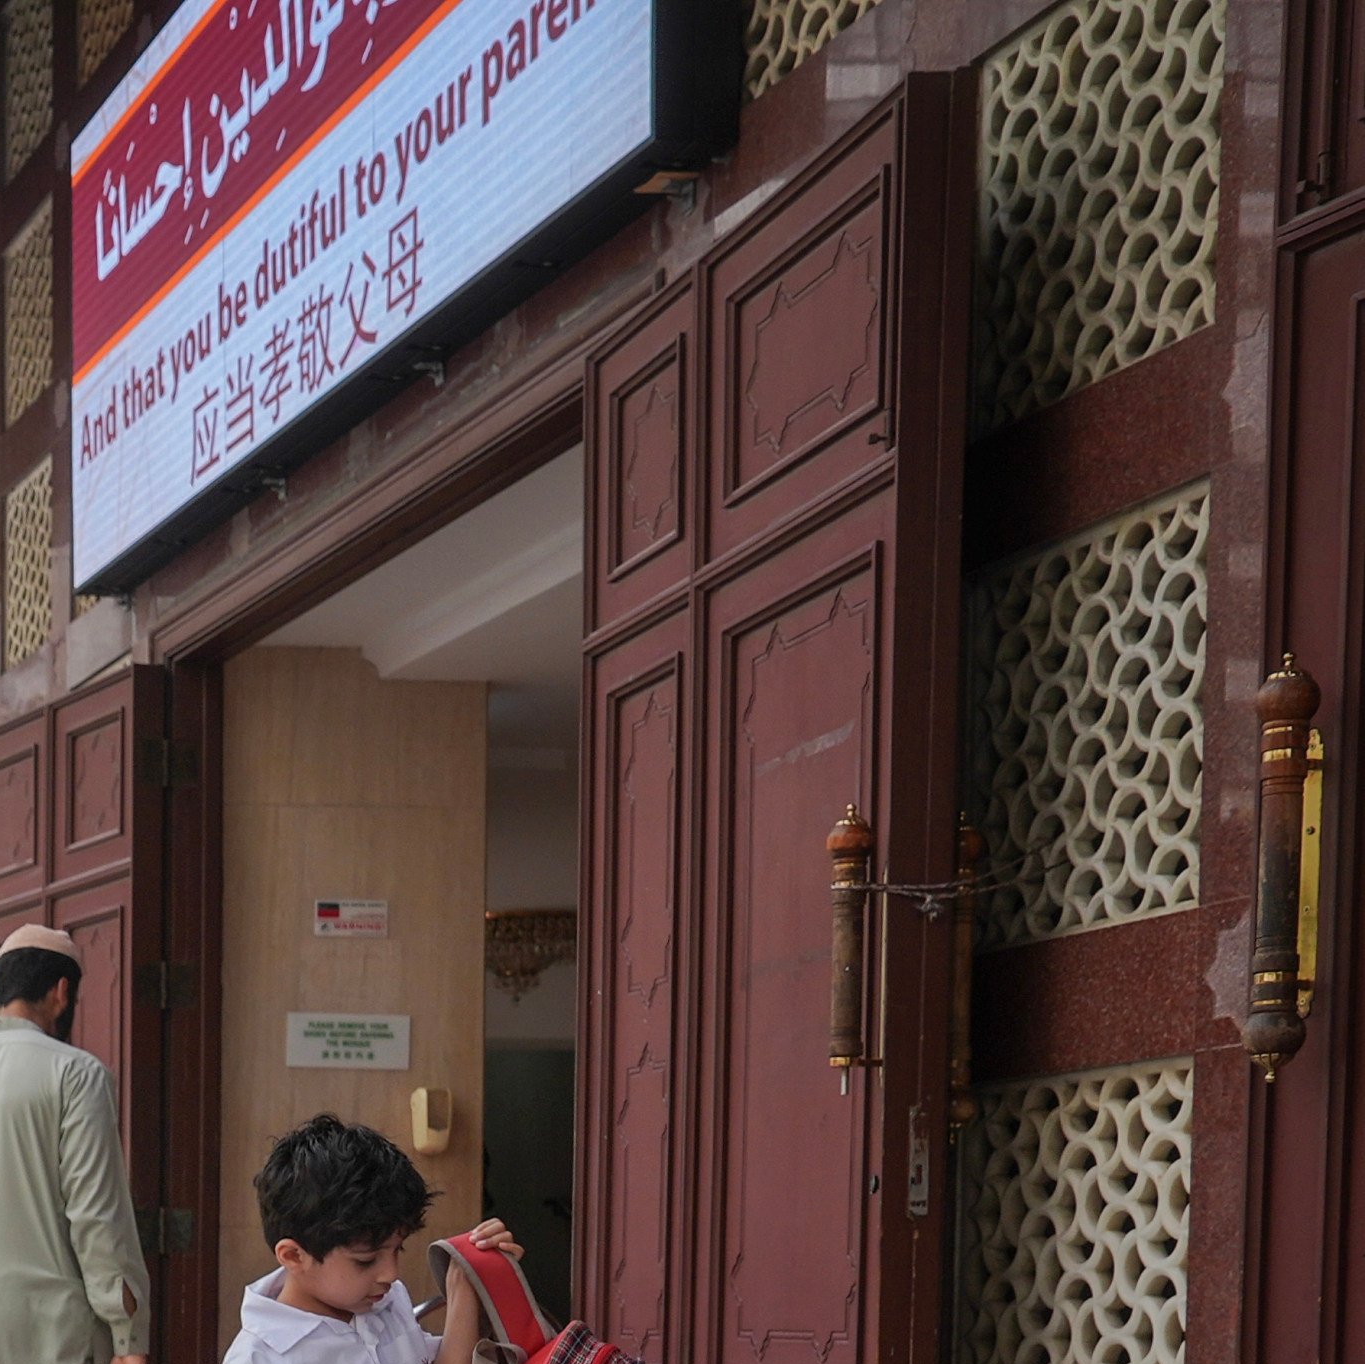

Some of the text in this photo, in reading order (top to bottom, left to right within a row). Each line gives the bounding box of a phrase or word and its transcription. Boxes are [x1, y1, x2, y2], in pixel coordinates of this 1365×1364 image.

[80, 385, 118, 469] And
[122, 347, 165, 430] that
[170, 311, 211, 405] you
[218, 280, 247, 346] be
[255, 164, 346, 310] dutiful
[354, 151, 385, 219] to
[394, 64, 472, 205] your
[189, 206, 425, 485] 应当孝敬父母
